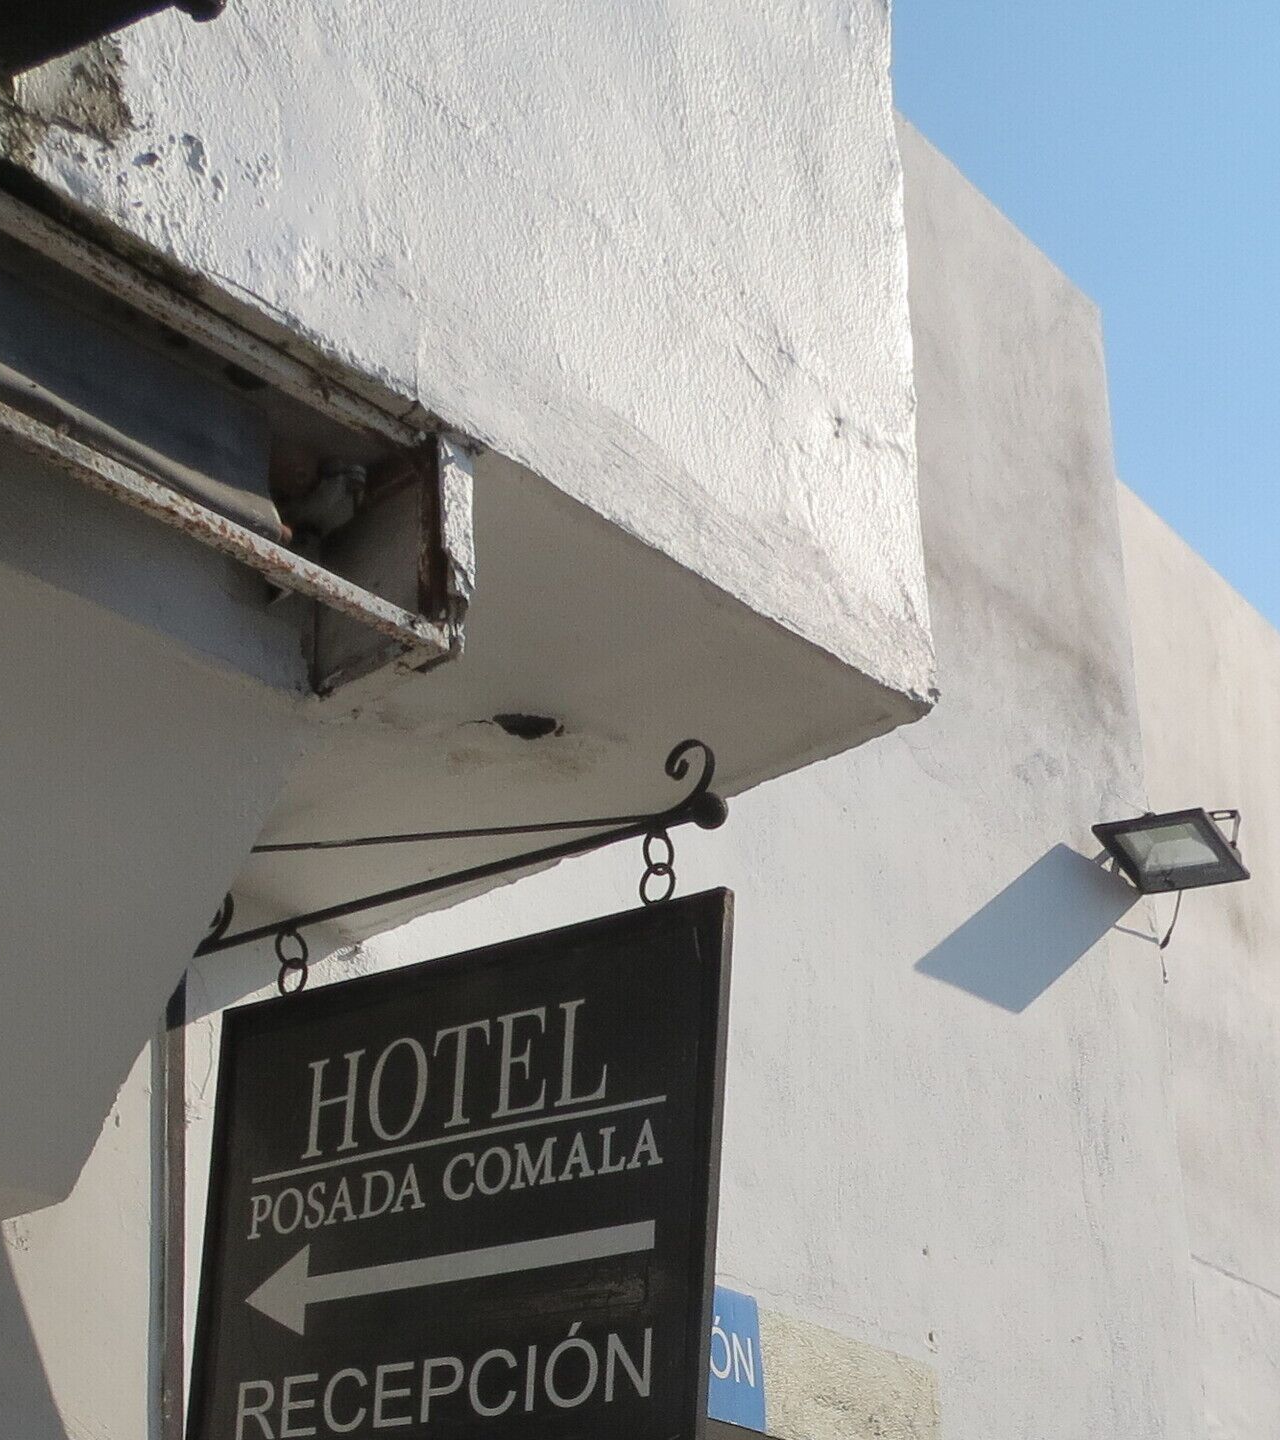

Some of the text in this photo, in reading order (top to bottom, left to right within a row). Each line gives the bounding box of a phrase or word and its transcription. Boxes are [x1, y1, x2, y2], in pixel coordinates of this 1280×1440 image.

[300, 999, 607, 1160] HOTEL
[247, 1118, 663, 1240] POSADA COMALA
